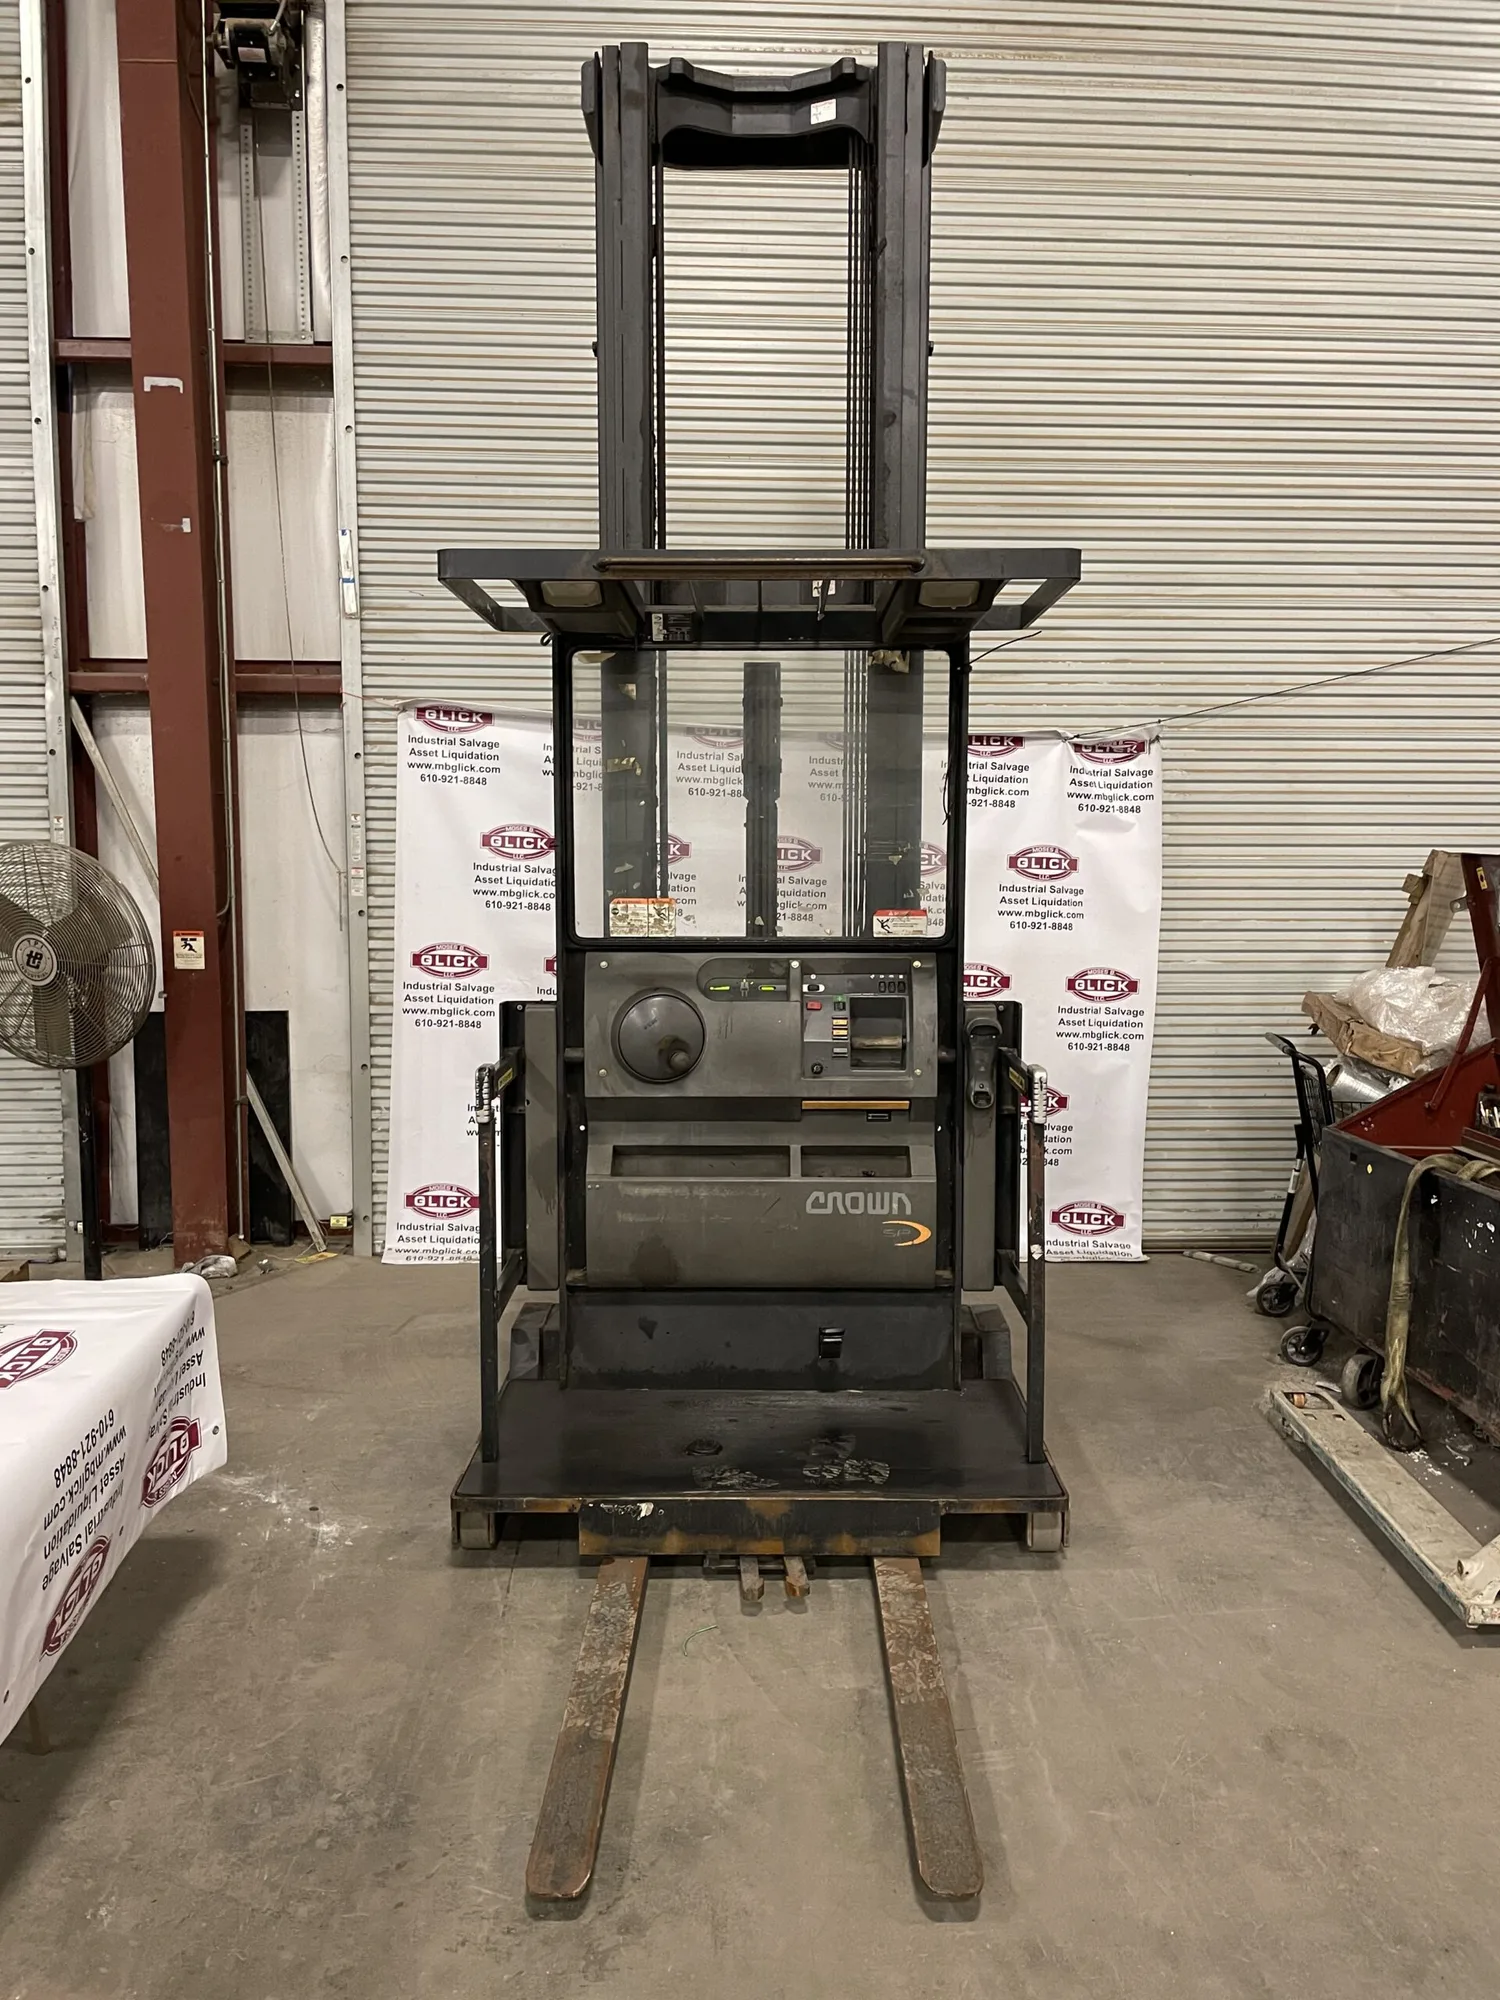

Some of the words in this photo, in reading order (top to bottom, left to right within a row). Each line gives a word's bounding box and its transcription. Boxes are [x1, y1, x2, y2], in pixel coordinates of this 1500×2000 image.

[424, 709, 484, 723] GLICK
[407, 734, 456, 746] Industrial
[459, 738, 500, 750] Salvage
[972, 735, 1015, 746] LICK
[409, 747, 438, 757] Asset
[441, 749, 500, 761] Liquidation
[676, 750, 725, 761] Industrial
[407, 761, 501, 774] www.mbglick.com
[677, 762, 707, 772] Asset
[709, 764, 742, 774] Liquid
[990, 761, 1030, 773] Salvage
[1114, 768, 1154, 778] Salvage
[420, 773, 488, 786] 610-921-8848
[675, 776, 743, 787] www.mbglick
[972, 774, 1029, 785] Liquidation
[967, 786, 1030, 797] mbglick.com
[1098, 781, 1153, 791] Liquidation
[688, 787, 742, 798] 610-921-88
[1067, 791, 1155, 803] www.mbglick.com
[968, 798, 1016, 809] -921-8848
[1078, 803, 1142, 814] 610-921-8848
[490, 835, 549, 849] GLICK
[473, 862, 521, 872] Industrial
[524, 864, 556, 877] Salvag
[1016, 857, 1071, 870] GLICK
[474, 875, 503, 885] Asset
[506, 876, 556, 887] Liquidatio
[788, 876, 828, 887] Salvage
[473, 888, 556, 899] www.mbglick.co
[777, 888, 827, 898] iquidation
[998, 884, 1047, 893] Industrial
[1049, 885, 1085, 896] Salvage
[485, 900, 551, 911] 610-921-8848
[999, 896, 1029, 905] Asset
[1031, 897, 1083, 908] Liquidation
[997, 909, 1084, 920] www.mbglick.com
[1009, 921, 1073, 931] 610-921-8848
[420, 954, 479, 967] GLICK
[402, 981, 452, 991] Industrial
[454, 983, 495, 994] Salvage
[1075, 979, 1129, 992] GLICK
[404, 994, 434, 1003] Asset
[437, 994, 494, 1005] Liquidation
[402, 1007, 496, 1017] www.mbglick.com
[1057, 1006, 1102, 1015] Industrial
[1104, 1007, 1145, 1018] Salvage
[415, 1018, 482, 1029] 610-921-8848
[1058, 1018, 1086, 1027] Asset
[1088, 1019, 1144, 1028] Liquidation
[1056, 1030, 1145, 1040] www.mbglick.com
[1067, 1042, 1131, 1051] 610-921-8848
[414, 1195, 472, 1208] GLICK
[805, 1191, 912, 1215] CROWN
[1059, 1213, 1115, 1225] GLICK
[396, 1222, 445, 1231] Industrial
[447, 1223, 480, 1234] Salvag
[883, 1228, 911, 1238] SP
[397, 1234, 427, 1243] Asset
[429, 1235, 480, 1245] Liquidatio
[1046, 1239, 1090, 1248] ndustrial
[394, 1247, 481, 1255] www.mbglick.co
[54, 1409, 114, 1488] 610-921-8848
[44, 1425, 126, 1531] www.mbglick.com
[100, 1452, 126, 1495] Asset
[44, 1485, 98, 1560] Liquidation
[42, 1533, 82, 1591] Salvage
